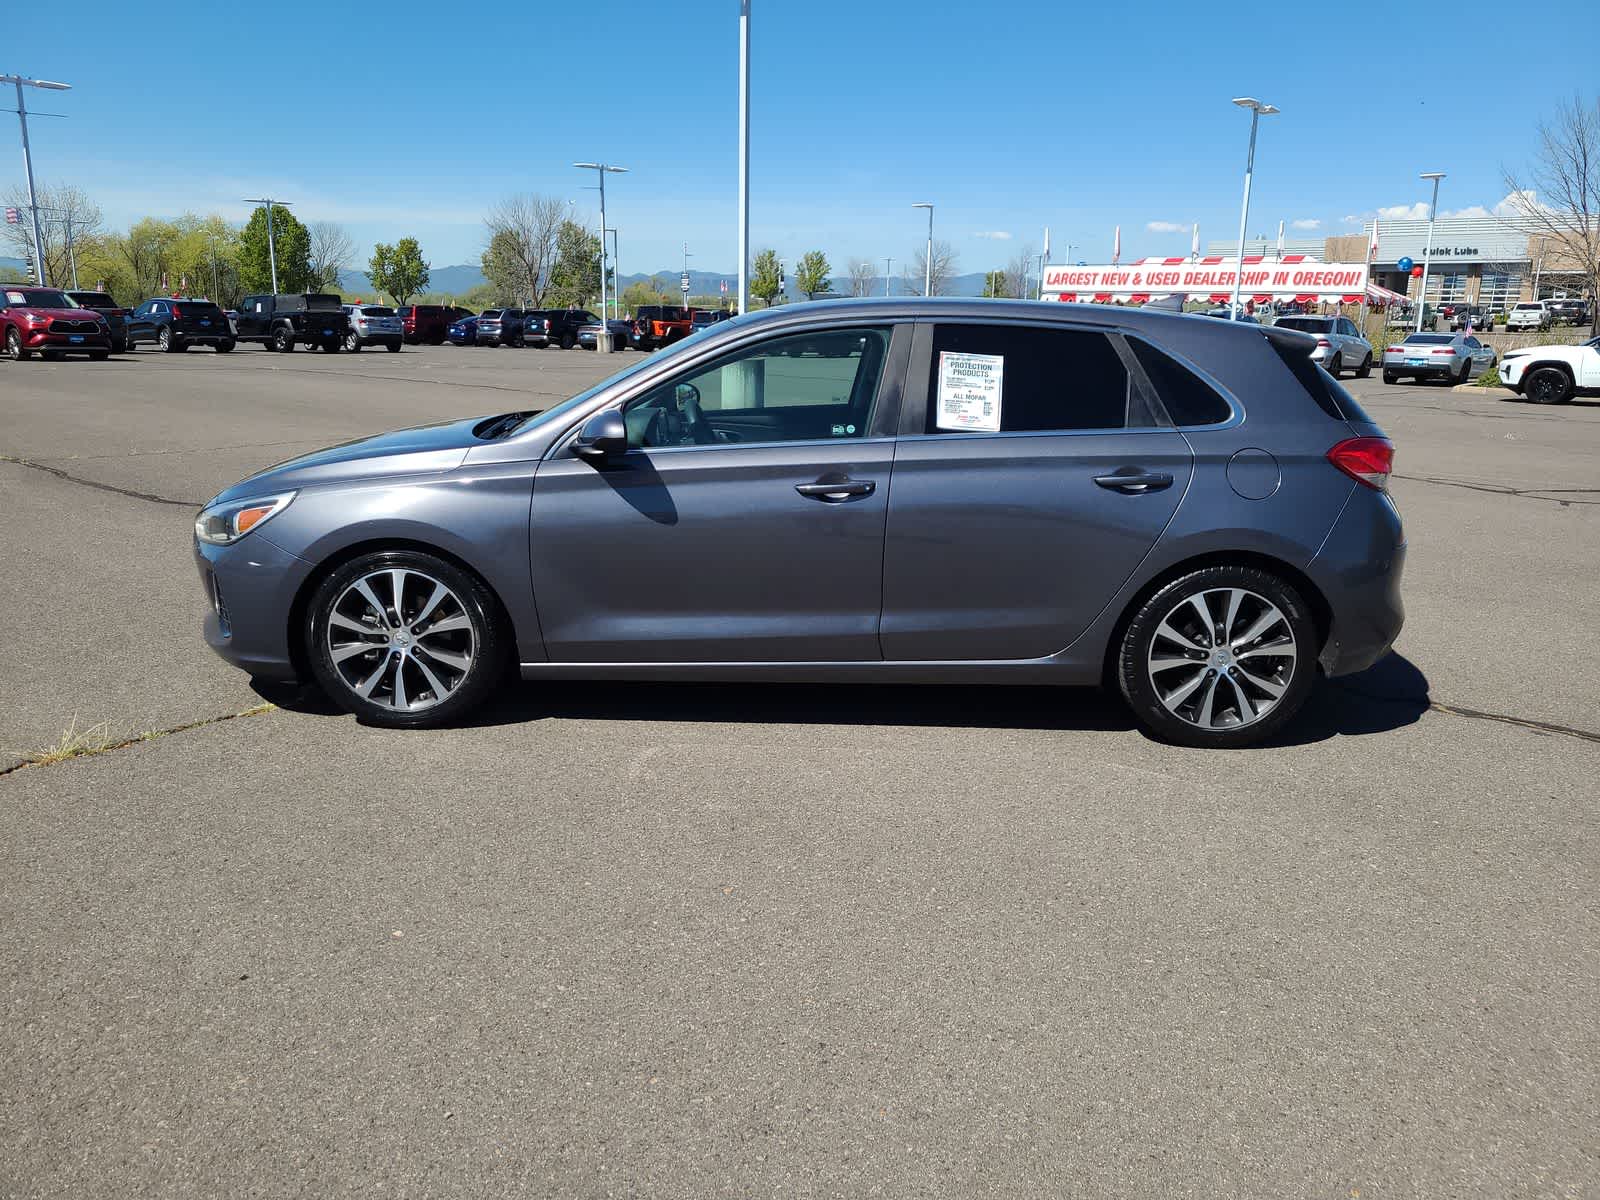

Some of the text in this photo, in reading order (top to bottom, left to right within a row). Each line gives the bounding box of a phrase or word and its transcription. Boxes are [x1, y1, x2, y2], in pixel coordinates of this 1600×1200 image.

[1047, 271, 1363, 286] LARGEST NEW & USED DEALERSHIP IN OREGON!
[950, 362, 993, 370] PROTECTION
[953, 369, 989, 378] PRODUCTS
